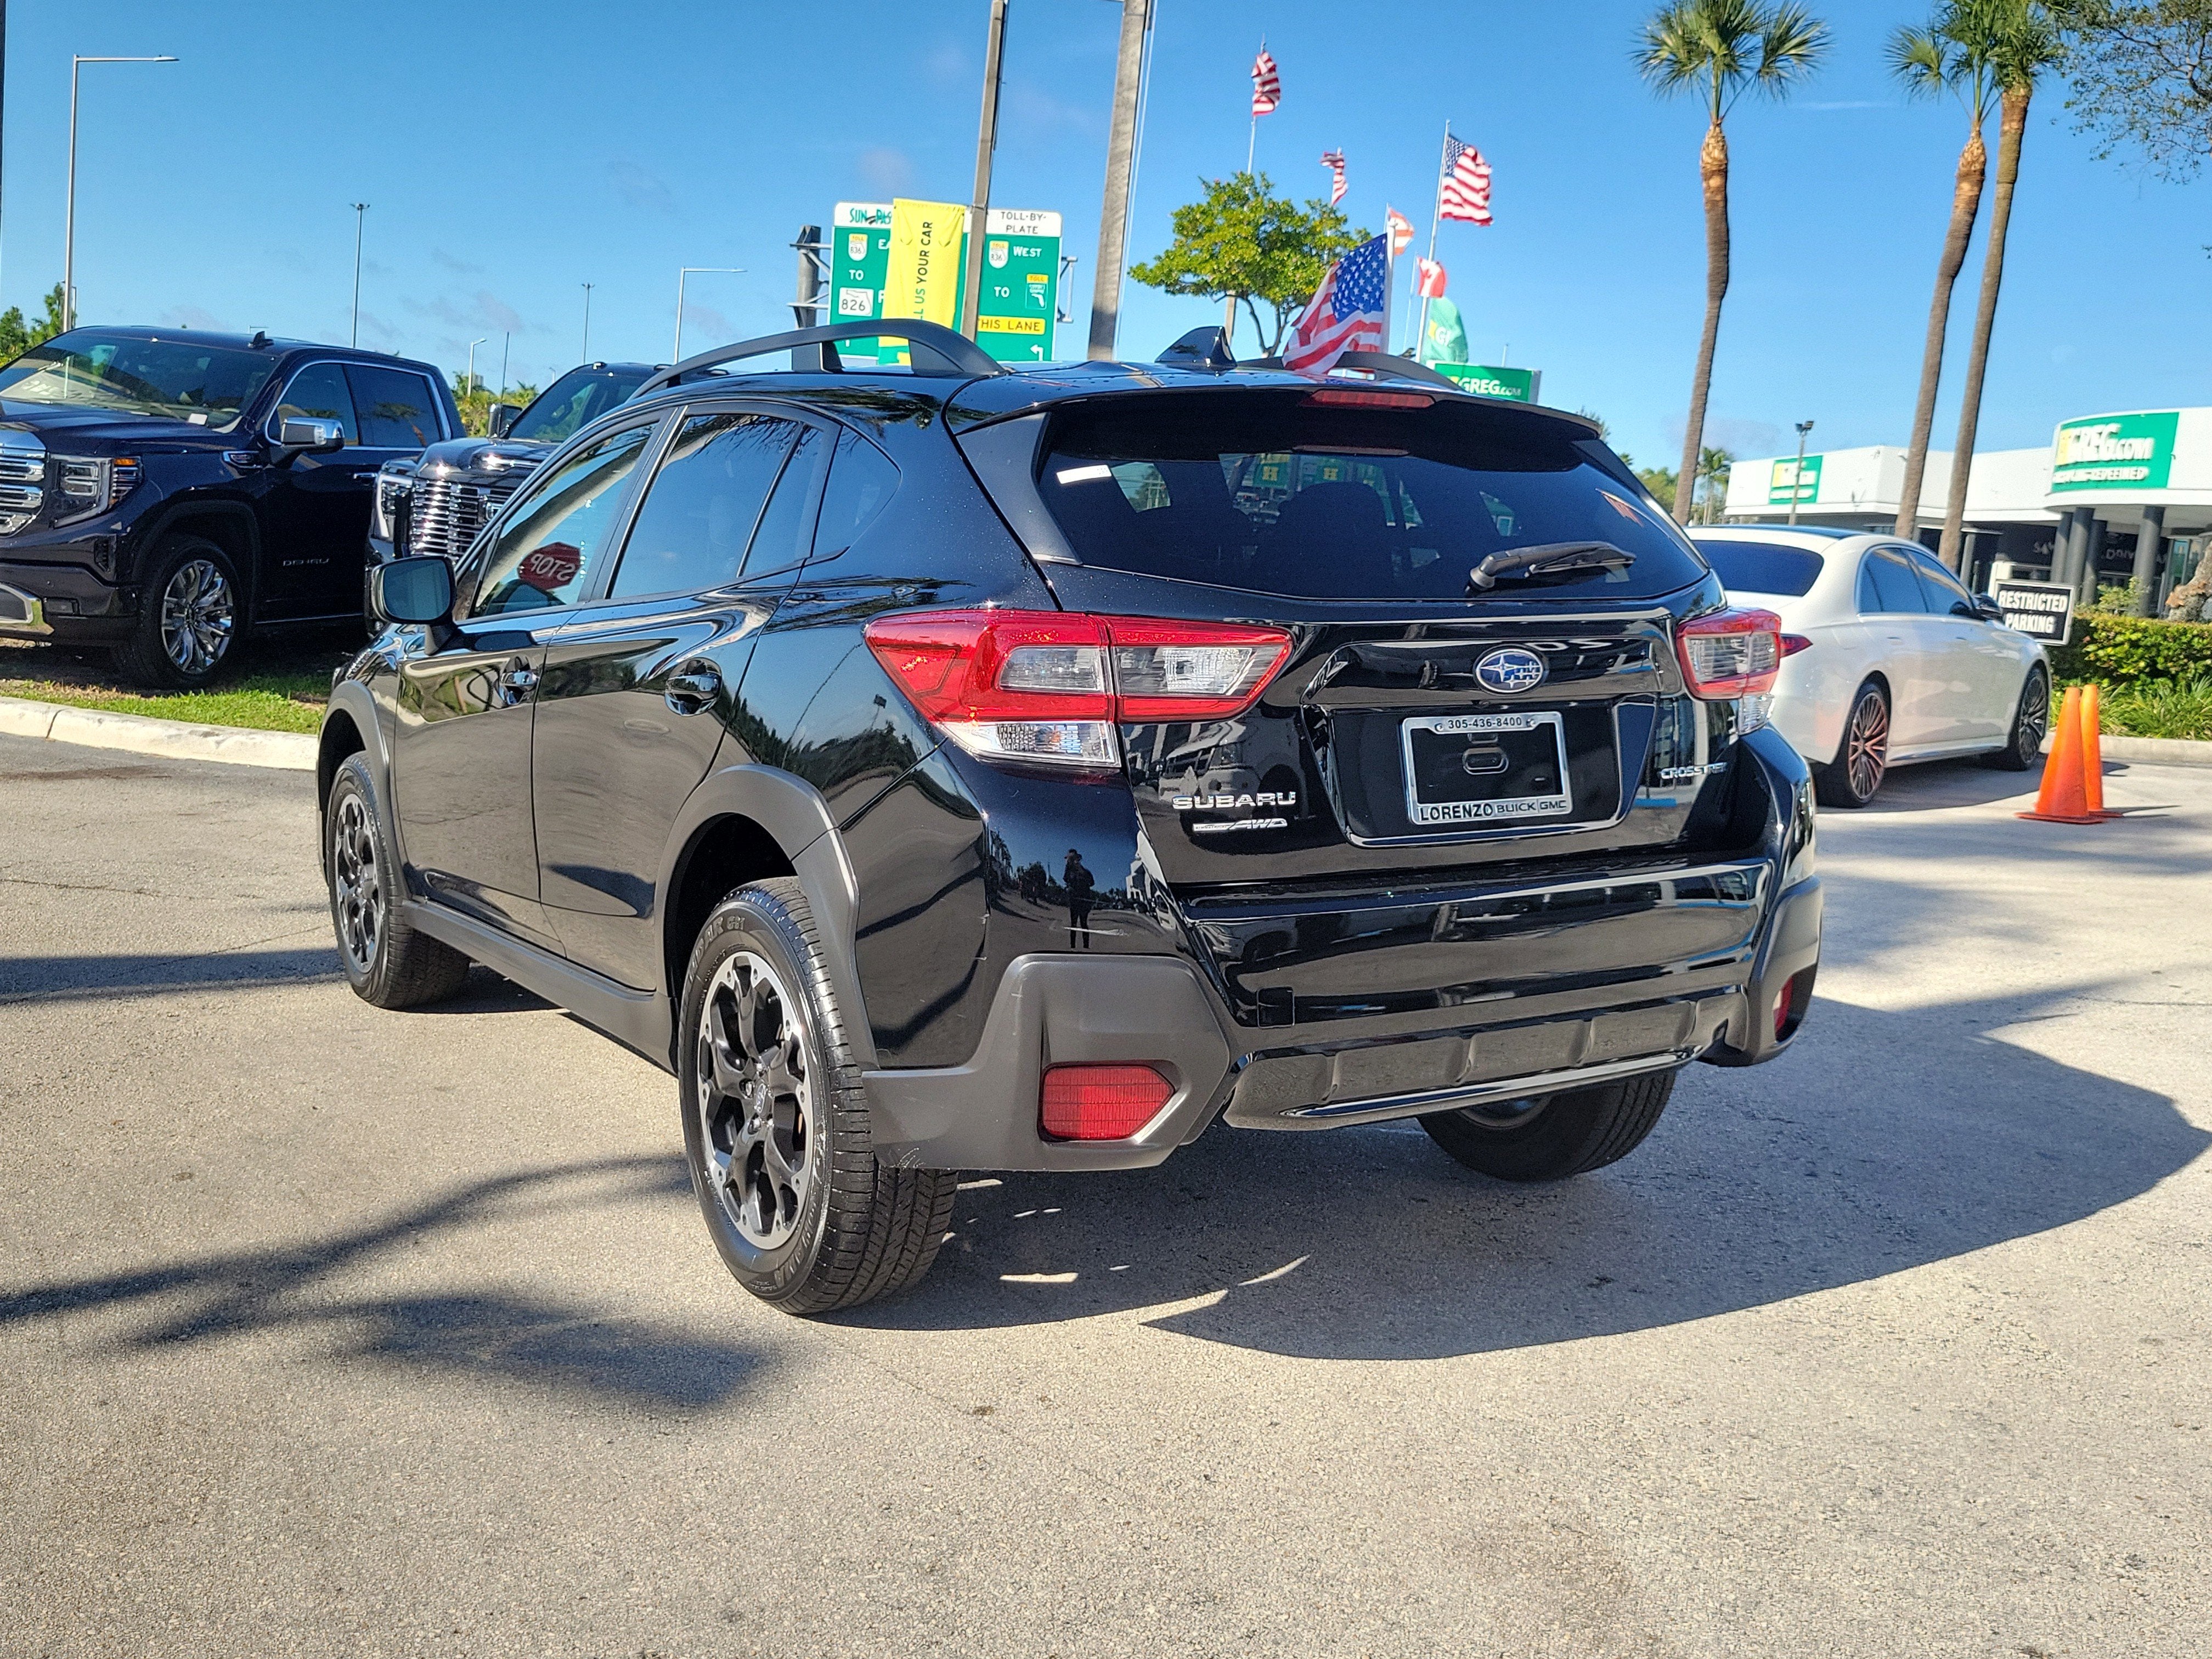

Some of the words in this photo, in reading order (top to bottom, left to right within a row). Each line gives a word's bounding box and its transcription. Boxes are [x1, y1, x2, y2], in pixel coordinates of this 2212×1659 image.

[921, 222, 933, 246] CAR
[1006, 224, 1038, 234] PLATE
[1013, 245, 1042, 258] WEST
[916, 250, 930, 284] YOUR
[849, 269, 864, 281] TO
[914, 288, 926, 303] US
[994, 286, 1010, 298] TO
[842, 298, 866, 312] 826
[979, 318, 1001, 330] HIS
[1008, 320, 1040, 332] LANE
[1998, 590, 2068, 612] RESTRICTED
[2005, 612, 2056, 634] PARKING
[1447, 716, 1522, 729] 305-436-8400
[1172, 791, 1296, 809] SUBARU
[1418, 803, 1493, 821] LORENZO
[1497, 802, 1536, 814] BUICK
[1539, 800, 1567, 810] GMC
[1229, 818, 1288, 830] AWD
